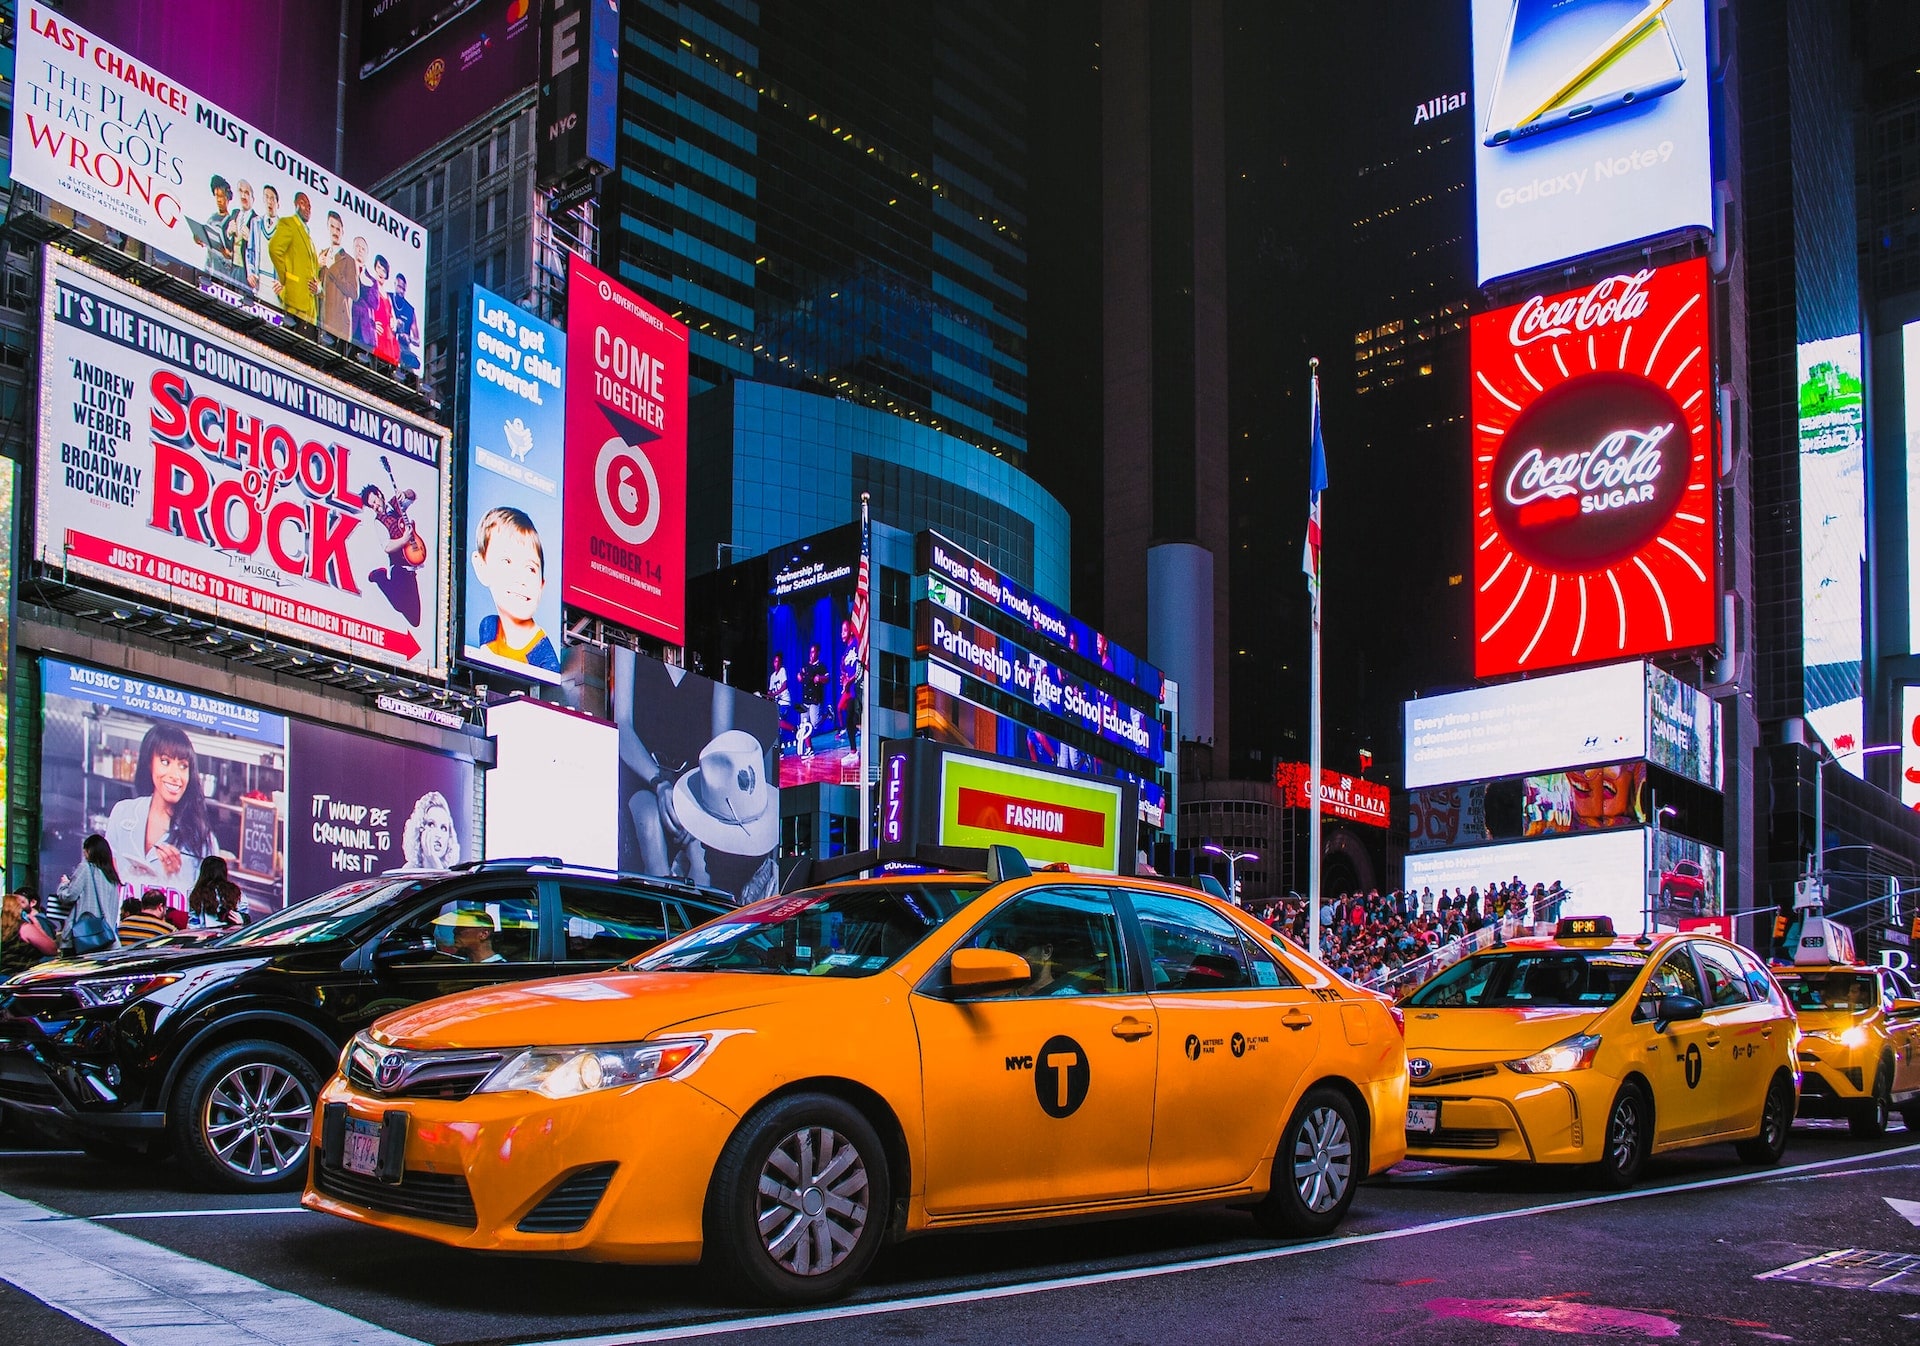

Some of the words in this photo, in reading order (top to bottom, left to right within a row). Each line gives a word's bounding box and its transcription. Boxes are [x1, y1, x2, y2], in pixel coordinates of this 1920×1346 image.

[43, 60, 91, 104] THE
[100, 85, 173, 145] PLAY
[27, 81, 94, 132] THAT
[100, 121, 183, 185] GOES
[31, 8, 88, 58] LAST
[94, 47, 187, 115] CHANCE!
[196, 103, 248, 149] MUST
[254, 138, 329, 196] CLOTHES
[334, 186, 409, 242] JANUARY
[411, 231, 421, 249] 6
[549, 112, 577, 141] NYC
[25, 113, 181, 228] WRONG
[1496, 167, 1588, 209] Galaxy
[1595, 141, 1674, 182] Note9
[74, 187, 95, 201] WEST
[98, 200, 117, 213] 45TH
[120, 209, 147, 226] STREET
[478, 299, 517, 339] Let's
[519, 325, 545, 354] get
[612, 291, 664, 332] ADVERTISINGWEEK
[1509, 268, 1657, 347] Coca-Cola
[56, 285, 95, 326] IT'S
[98, 303, 135, 342] THE
[138, 318, 191, 366] FINAL
[194, 342, 304, 411] COUNTDOWN!
[307, 388, 347, 428] THRU
[350, 408, 380, 440] JAN
[382, 422, 401, 448] 20
[404, 428, 439, 463] ONLY
[477, 331, 521, 371] every
[524, 354, 561, 388] child
[594, 326, 665, 403] COME
[81, 383, 126, 418] LLOYD
[476, 358, 543, 405] covered.
[594, 371, 665, 430] TOGETHER
[73, 402, 131, 442] WEBBER
[150, 369, 364, 514] SCHOOL
[88, 430, 116, 458] HAS
[1506, 422, 1674, 505] Coca-Cola
[61, 442, 142, 488] BROADWAY
[243, 468, 285, 512] of
[1581, 484, 1655, 513] SUGAR
[147, 438, 362, 598] ROCK
[234, 555, 246, 565] THE
[243, 564, 282, 582] MUSICAL
[590, 535, 642, 574] OCTOBER
[645, 559, 662, 583] 1-4
[776, 565, 813, 584] Partnership
[814, 562, 824, 573] for
[108, 548, 144, 572] JUST
[146, 562, 155, 577] 4
[158, 562, 207, 592] BLOCKS
[208, 578, 224, 598] TO
[227, 584, 249, 606] THE
[251, 592, 295, 620] WINTER
[297, 606, 340, 634] GARDEN
[341, 619, 385, 647] THEATRE
[776, 583, 793, 595] After
[793, 577, 816, 590] School
[817, 565, 851, 583] Education
[934, 546, 969, 582] Morgan
[970, 568, 1001, 602] Stanley
[1003, 586, 1032, 620] Proudly
[1032, 605, 1067, 638] Supports
[69, 666, 120, 690] MUSIC
[124, 679, 143, 696] BY
[147, 683, 186, 706] SARA
[189, 694, 260, 724] BAREILLES
[933, 617, 1011, 684] Partnership
[1013, 660, 1031, 690] for
[1034, 671, 1062, 705] After
[1064, 685, 1101, 724] School
[1103, 705, 1149, 748] Education
[1414, 737, 1421, 746] a
[1422, 728, 1471, 744] donation
[1472, 727, 1485, 737] to
[1414, 743, 1468, 761] childhood
[1653, 717, 1678, 745] SANTA
[1678, 730, 1689, 750] FE
[312, 795, 330, 818] IT
[329, 800, 367, 824] WOULD
[369, 807, 391, 827] BE
[1304, 781, 1350, 804] COWNE
[1355, 794, 1386, 813] PLAZA
[1335, 806, 1357, 817] HOTEL
[312, 822, 375, 850] CRIMINAL
[375, 831, 390, 850] TO
[1006, 804, 1064, 833] FASHION
[245, 828, 273, 855] EGGS
[332, 849, 360, 872] MISS
[363, 855, 378, 873] IT
[1412, 860, 1444, 872] Thanks
[1445, 860, 1455, 868] to
[1573, 920, 1596, 933] 9P96
[1005, 1055, 1033, 1071] NYC
[1047, 1052, 1077, 1107] T
[1689, 1052, 1698, 1083] T
